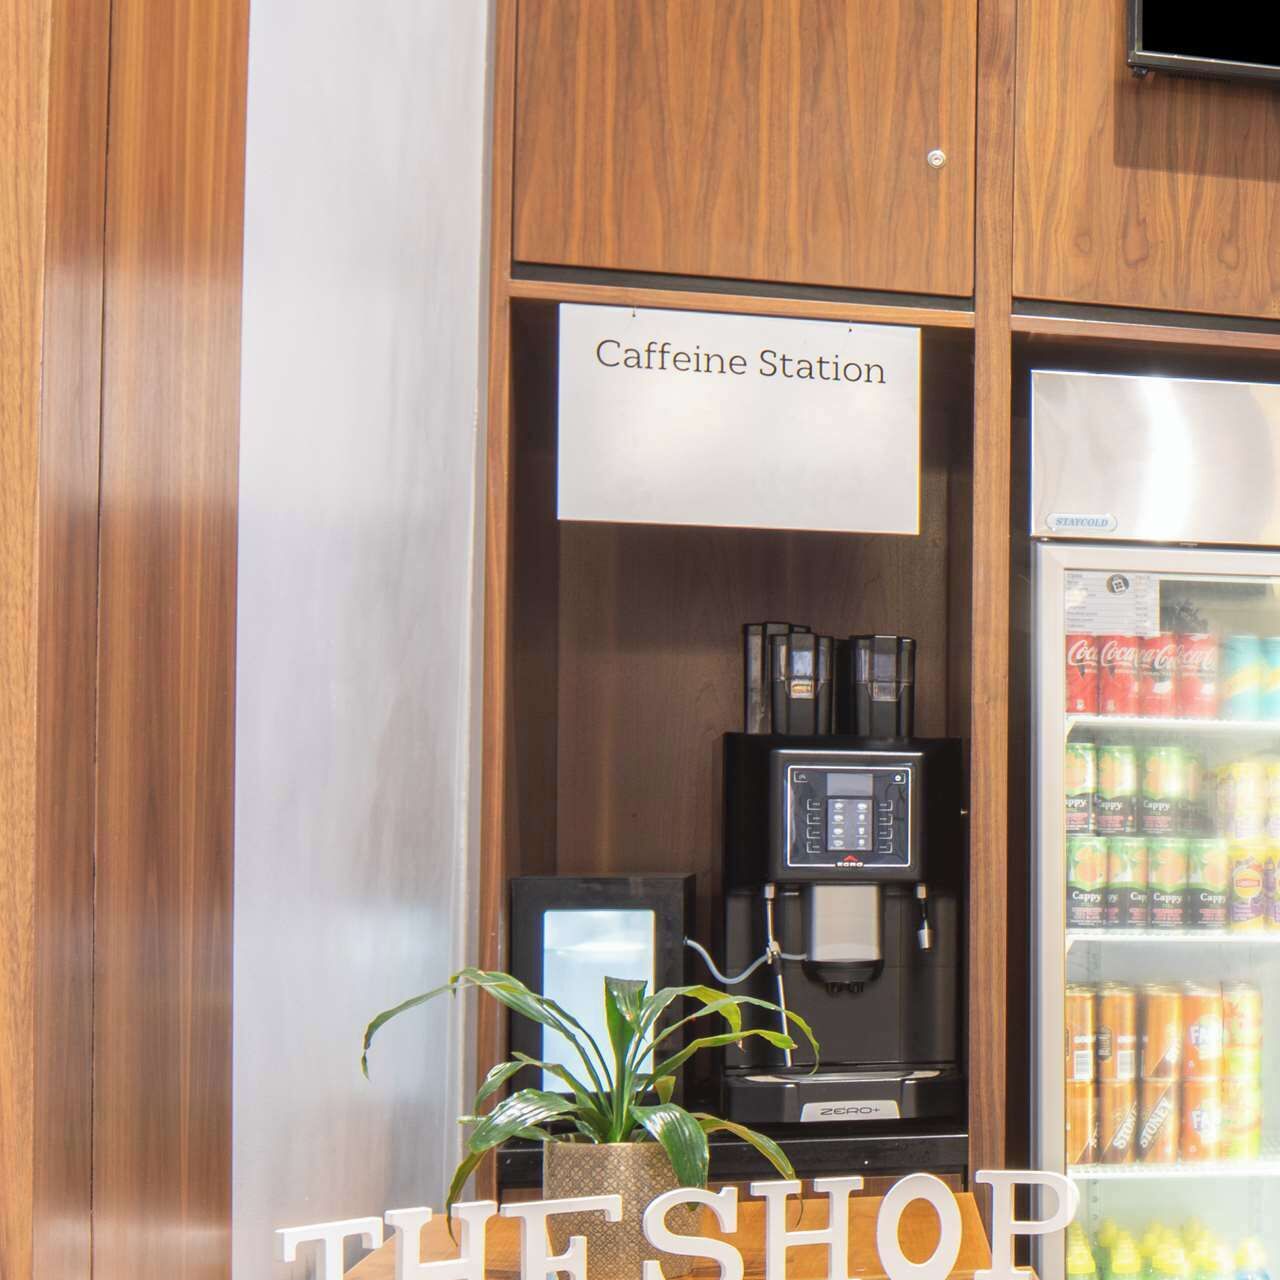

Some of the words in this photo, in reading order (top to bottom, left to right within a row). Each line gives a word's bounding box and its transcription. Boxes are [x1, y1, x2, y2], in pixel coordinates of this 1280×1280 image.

[595, 338, 748, 376] Caffeine
[759, 348, 887, 385] Station
[1055, 517, 1109, 528] STAYCOLD
[1072, 891, 1102, 904] Cappy
[1153, 892, 1183, 905] Cappy
[820, 1106, 880, 1116] ZERO+
